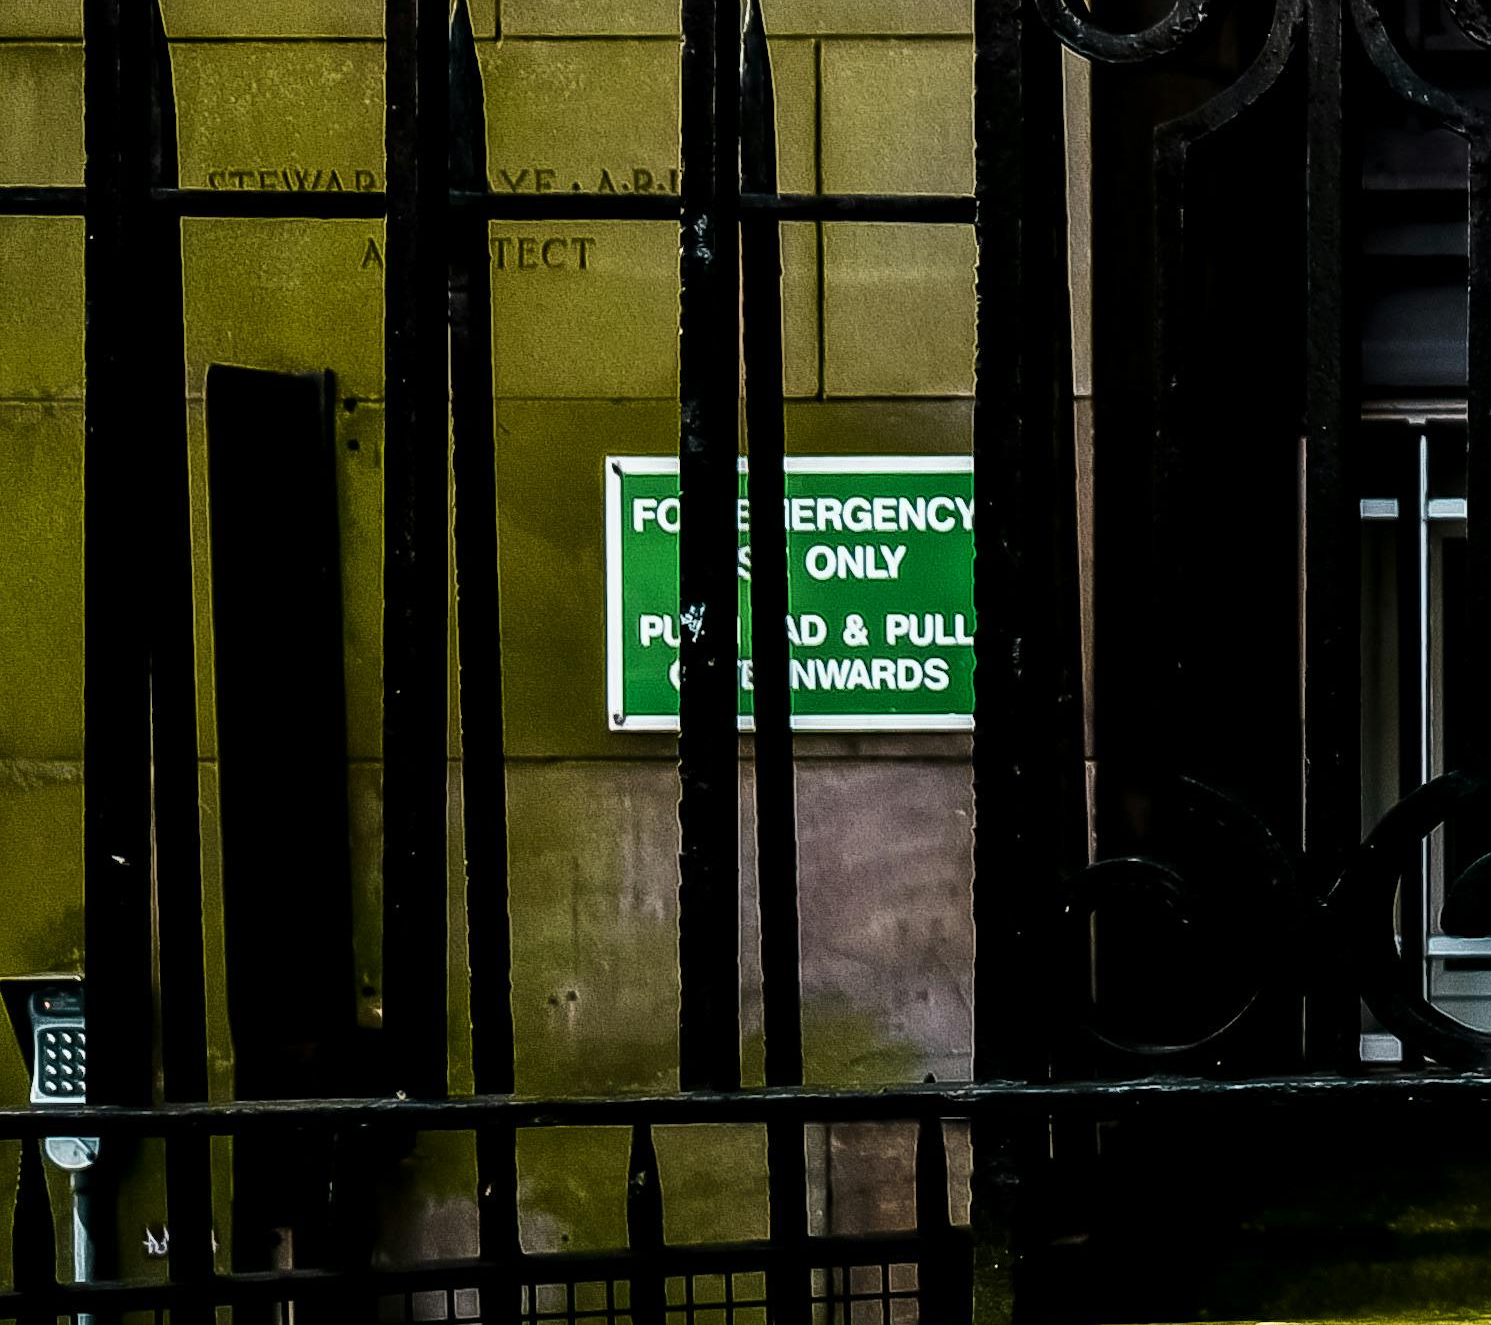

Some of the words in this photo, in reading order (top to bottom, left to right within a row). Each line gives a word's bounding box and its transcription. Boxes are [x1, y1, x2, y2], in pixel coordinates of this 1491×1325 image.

[632, 497, 681, 533] FO
[738, 497, 974, 533] EERGENCY
[805, 544, 907, 580] ONLY
[842, 613, 870, 647] &
[885, 613, 975, 646] PULL
